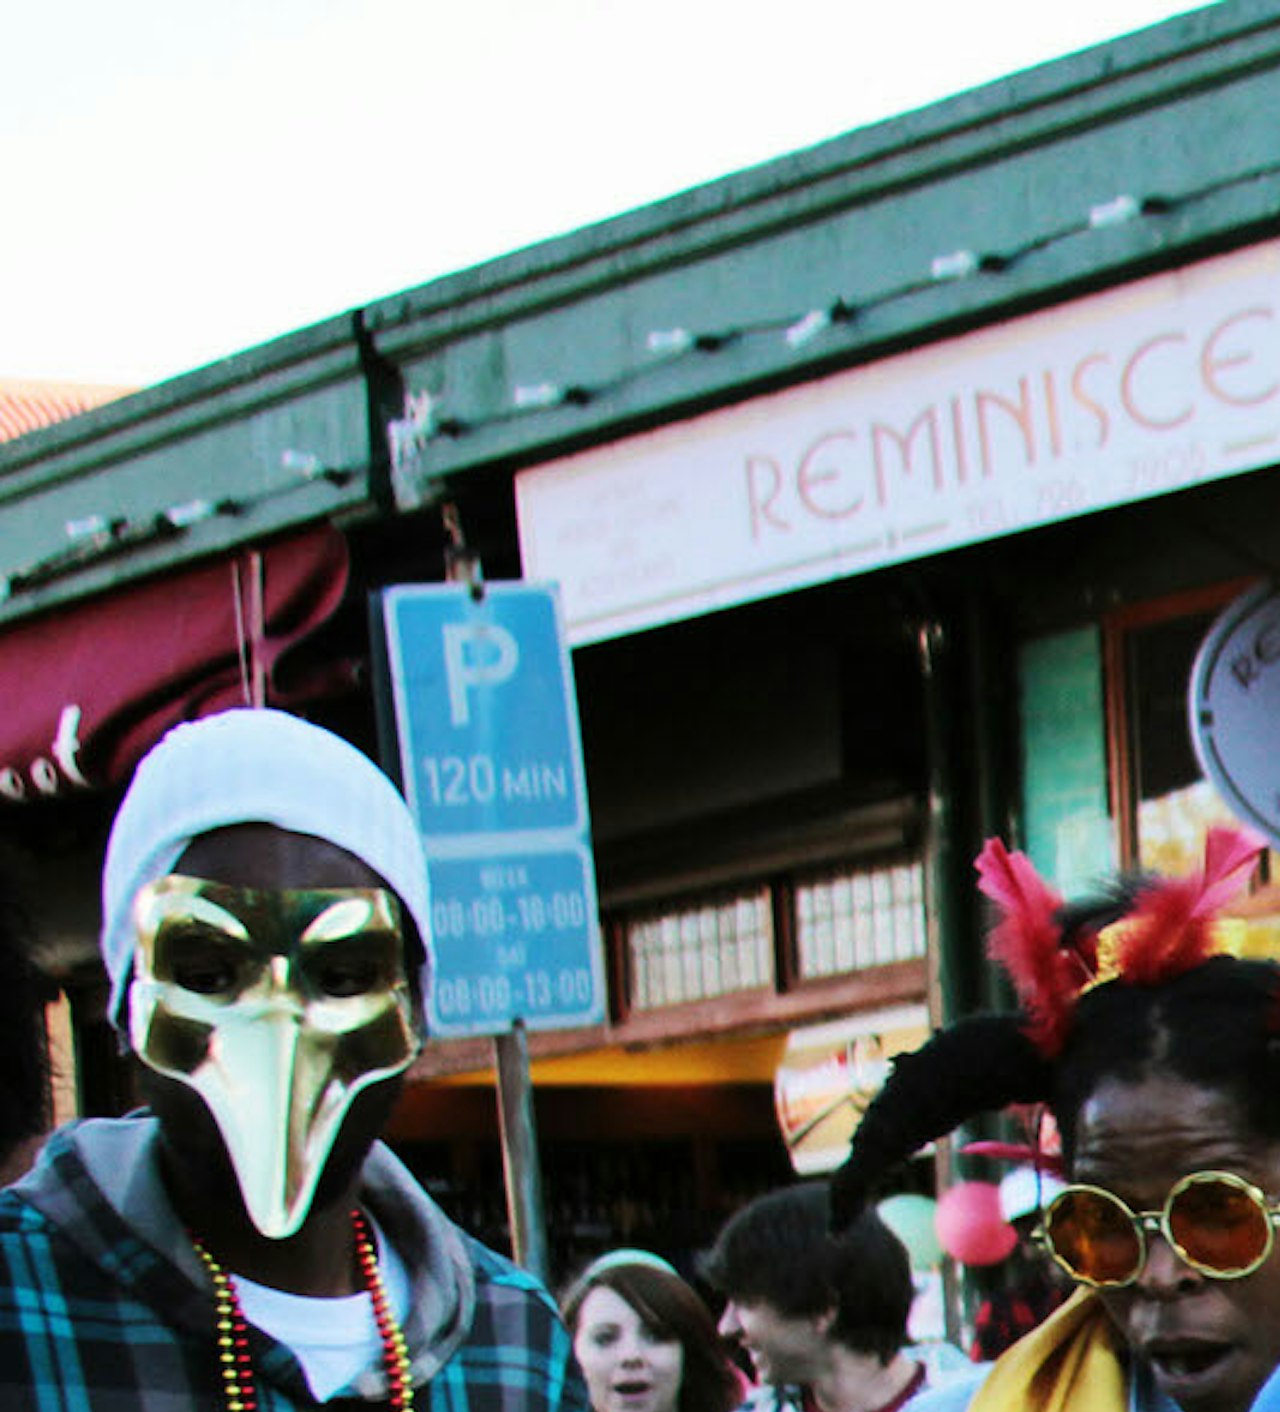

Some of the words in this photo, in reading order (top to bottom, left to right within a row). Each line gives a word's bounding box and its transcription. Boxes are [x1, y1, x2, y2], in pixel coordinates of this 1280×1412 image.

[442, 622, 519, 726] P
[423, 755, 495, 806] 120
[502, 761, 568, 799] MIN
